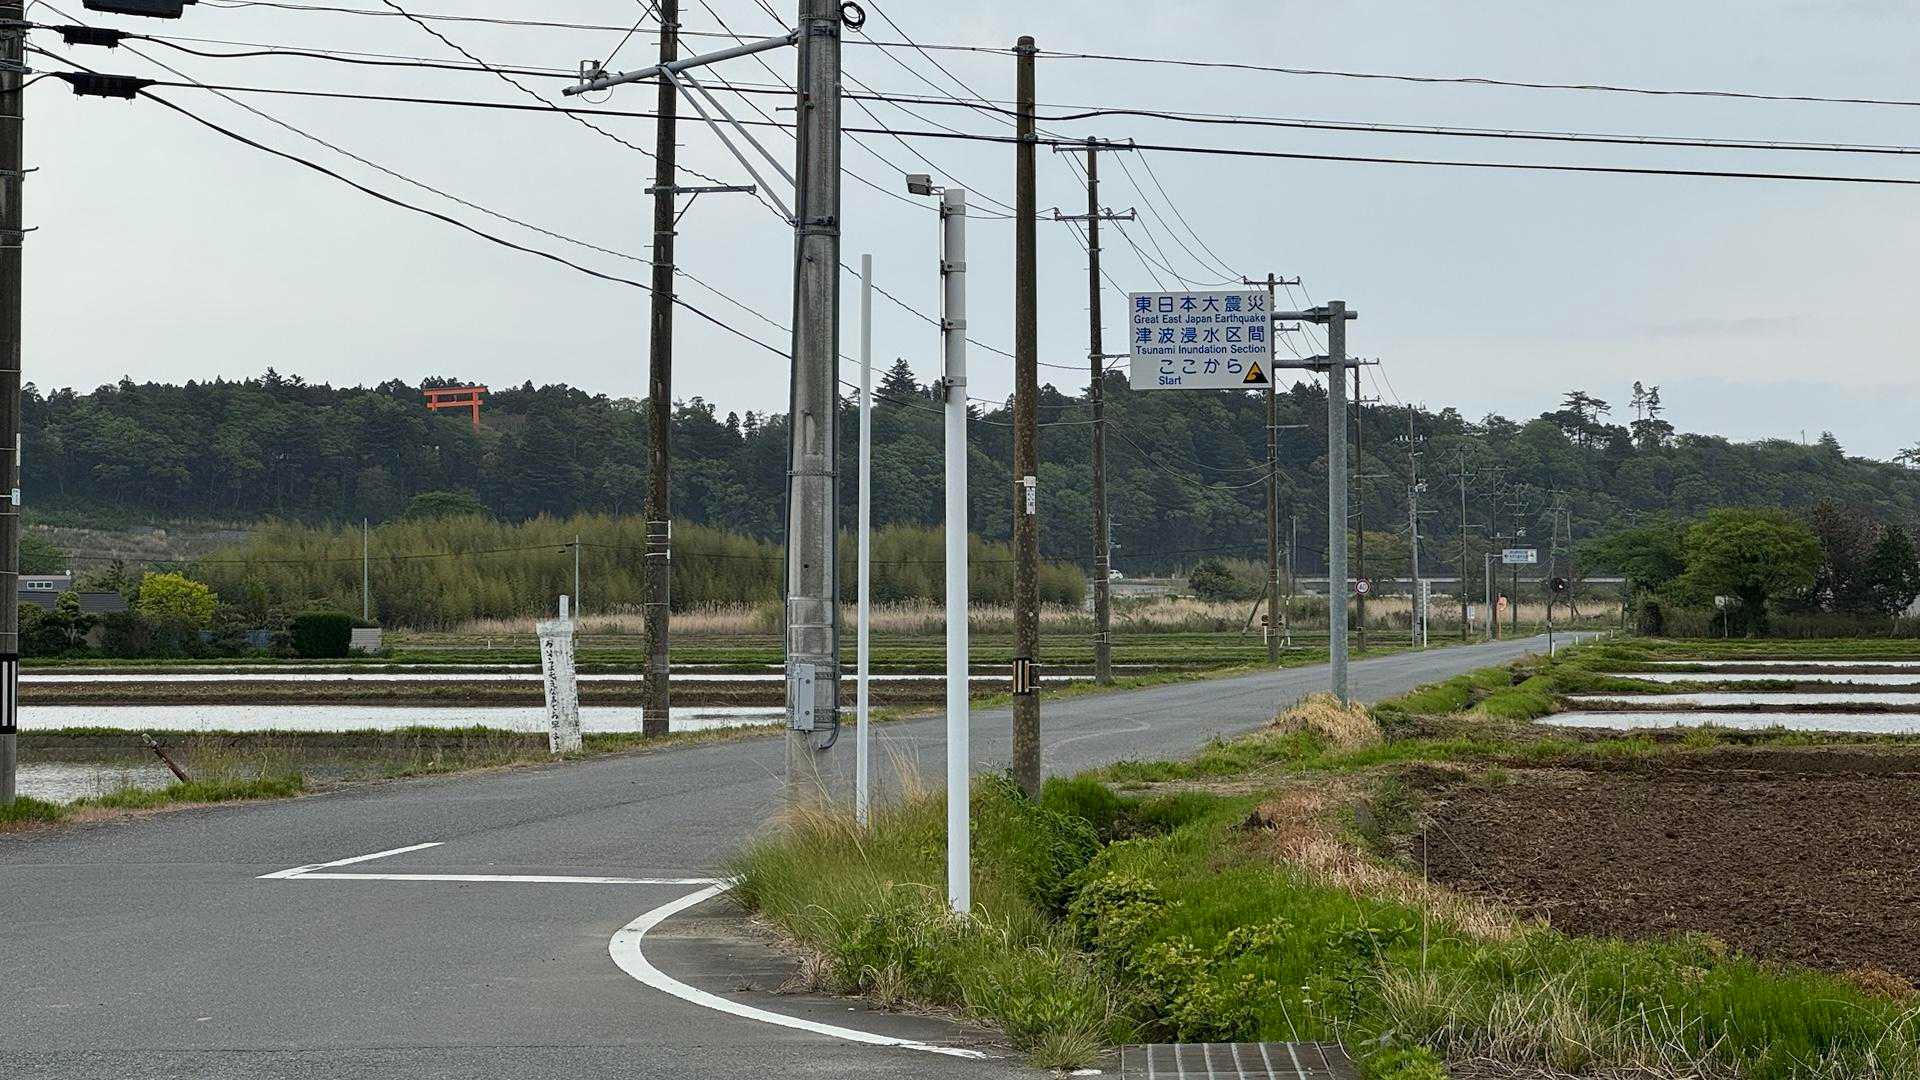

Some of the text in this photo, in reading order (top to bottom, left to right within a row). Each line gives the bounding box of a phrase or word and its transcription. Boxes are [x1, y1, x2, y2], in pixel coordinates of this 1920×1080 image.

[1135, 295, 1265, 313] 東日本大震災
[1134, 314, 1265, 325] Great East Japan Earthquake
[1135, 326, 1265, 344] 津波浸水区間
[1136, 345, 1266, 355] Tsunami Inundation Section
[1159, 358, 1243, 374] ここから
[1158, 376, 1182, 385] Start
